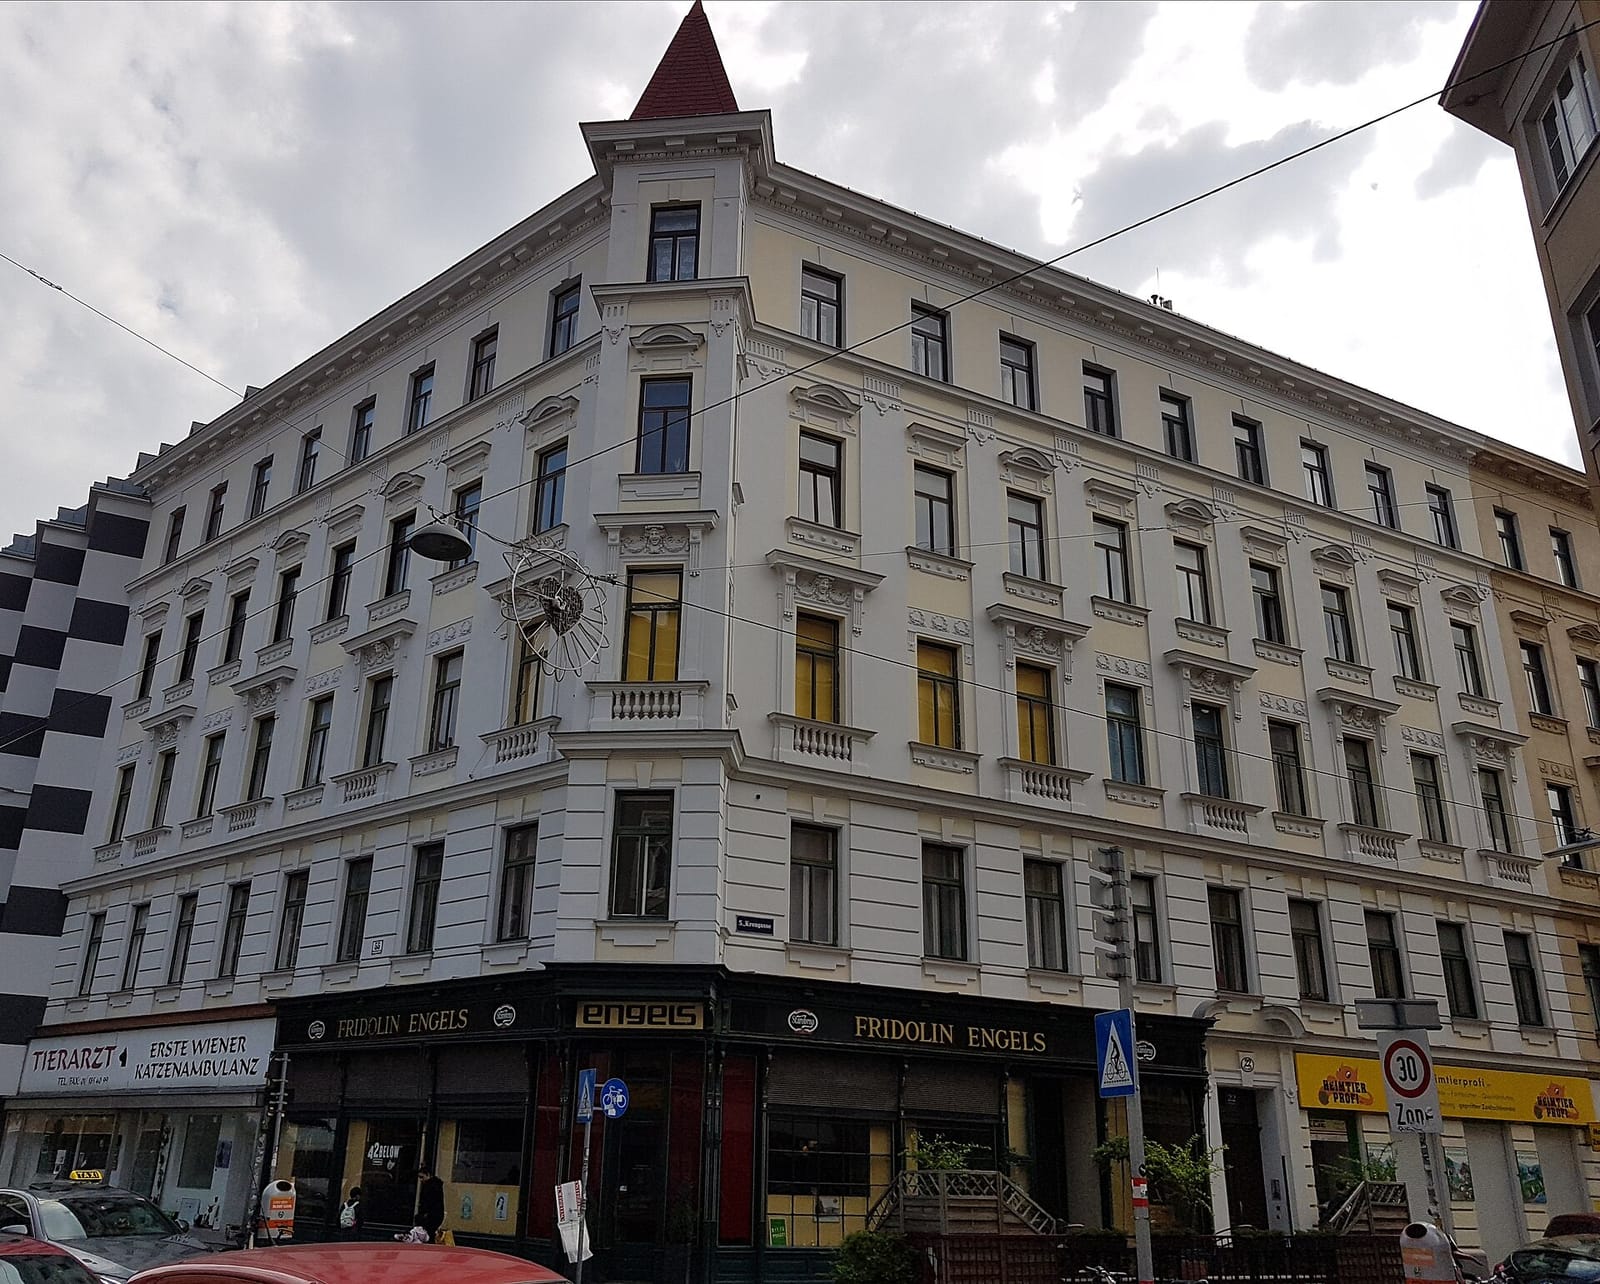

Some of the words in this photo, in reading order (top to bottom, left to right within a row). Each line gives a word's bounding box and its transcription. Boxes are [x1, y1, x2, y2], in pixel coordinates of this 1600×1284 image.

[337, 1014, 401, 1038] FRIDOLIN
[408, 1008, 469, 1033] ENGELS
[582, 1004, 697, 1026] engels
[854, 1015, 955, 1044] FRIDOLIN
[967, 1026, 1047, 1053] ENGELS
[149, 1040, 189, 1059] ERSTE
[192, 1036, 247, 1056] WIENER
[32, 1045, 118, 1073] TIERARZT
[134, 1058, 260, 1080] KATZENAMBULANZ
[1396, 1055, 1418, 1082] 30
[1323, 1079, 1368, 1094] HEIMTIER
[1333, 1092, 1360, 1105] PROFI
[1537, 1095, 1574, 1109] HEIMTIER
[77, 1171, 99, 1179] TAXI
